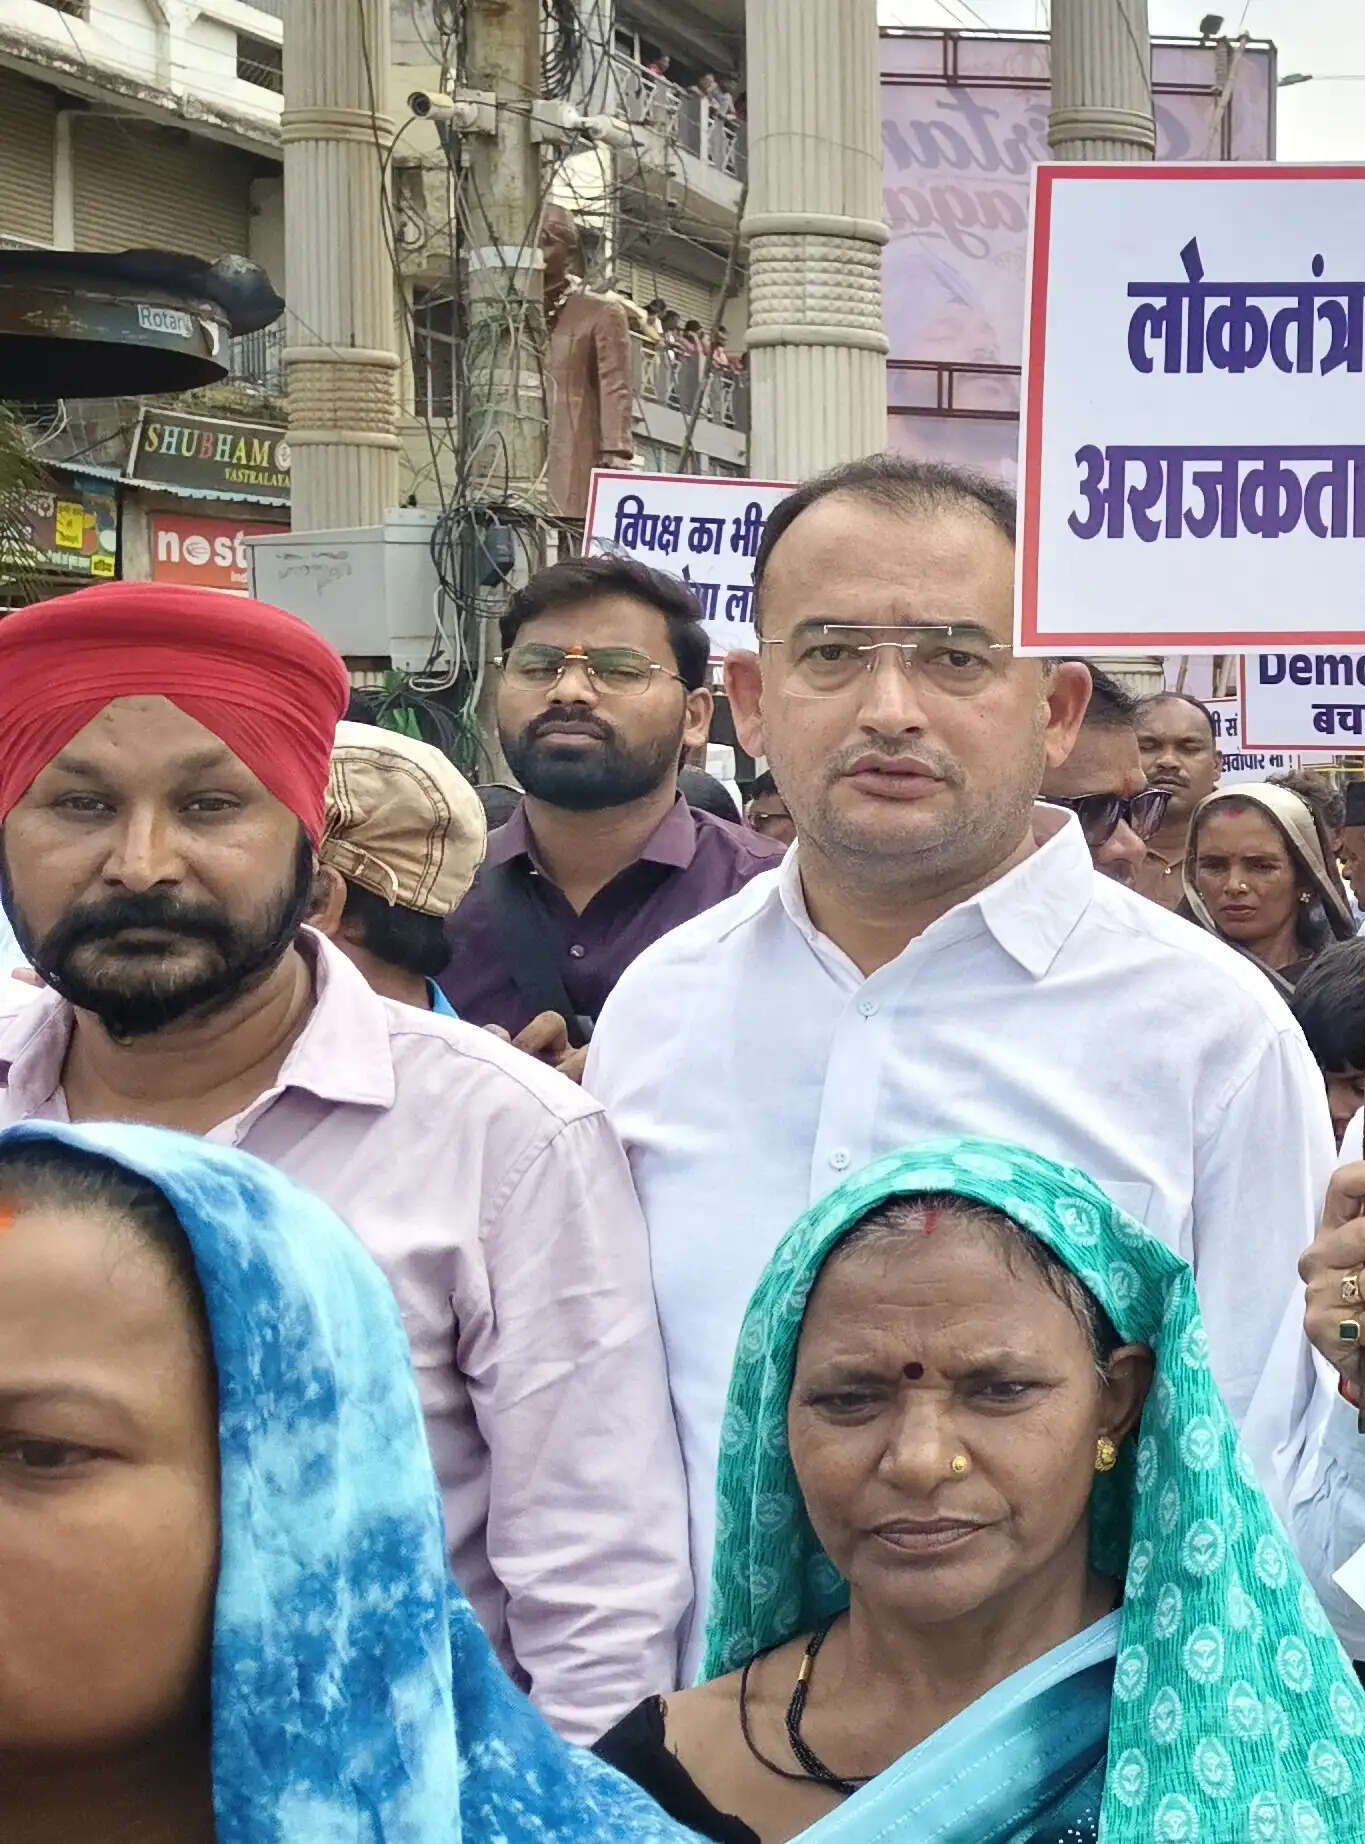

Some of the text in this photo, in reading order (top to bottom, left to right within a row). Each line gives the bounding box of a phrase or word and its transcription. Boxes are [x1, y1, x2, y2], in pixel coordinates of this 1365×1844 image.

[144, 424, 272, 467] SHUBHAM
[614, 495, 683, 556] विपक्ष
[687, 517, 726, 555] का
